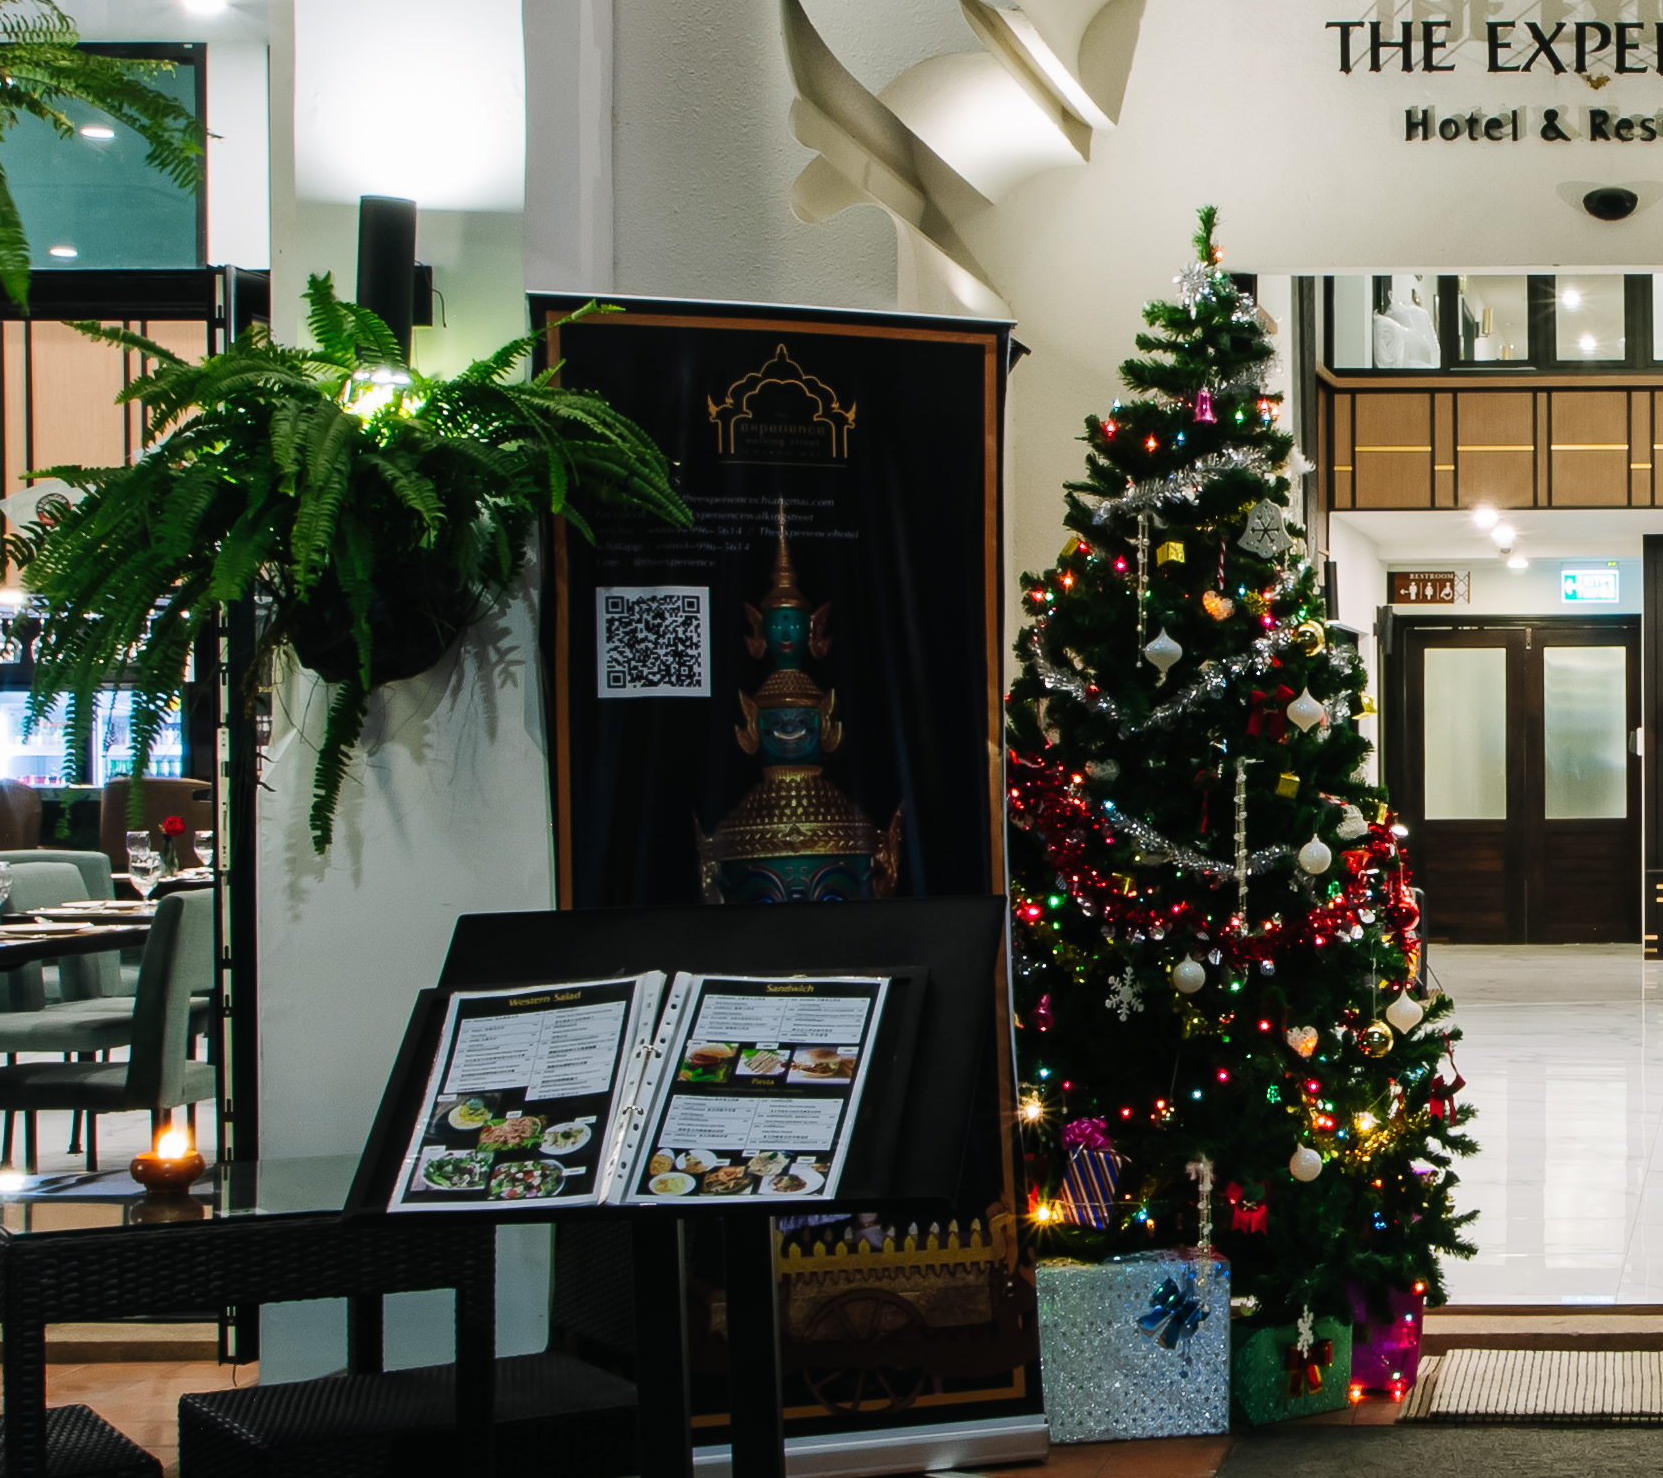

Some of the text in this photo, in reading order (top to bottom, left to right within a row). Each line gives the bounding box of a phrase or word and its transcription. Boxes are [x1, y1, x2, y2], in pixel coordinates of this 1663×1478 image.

[1325, 20, 1456, 75] THE
[1404, 108, 1519, 142] Hotel
[1539, 108, 1572, 142] &
[682, 493, 835, 508] theexperiencechiangmai.com
[765, 983, 815, 993] Sandwich
[508, 990, 582, 1007] Western Salad
